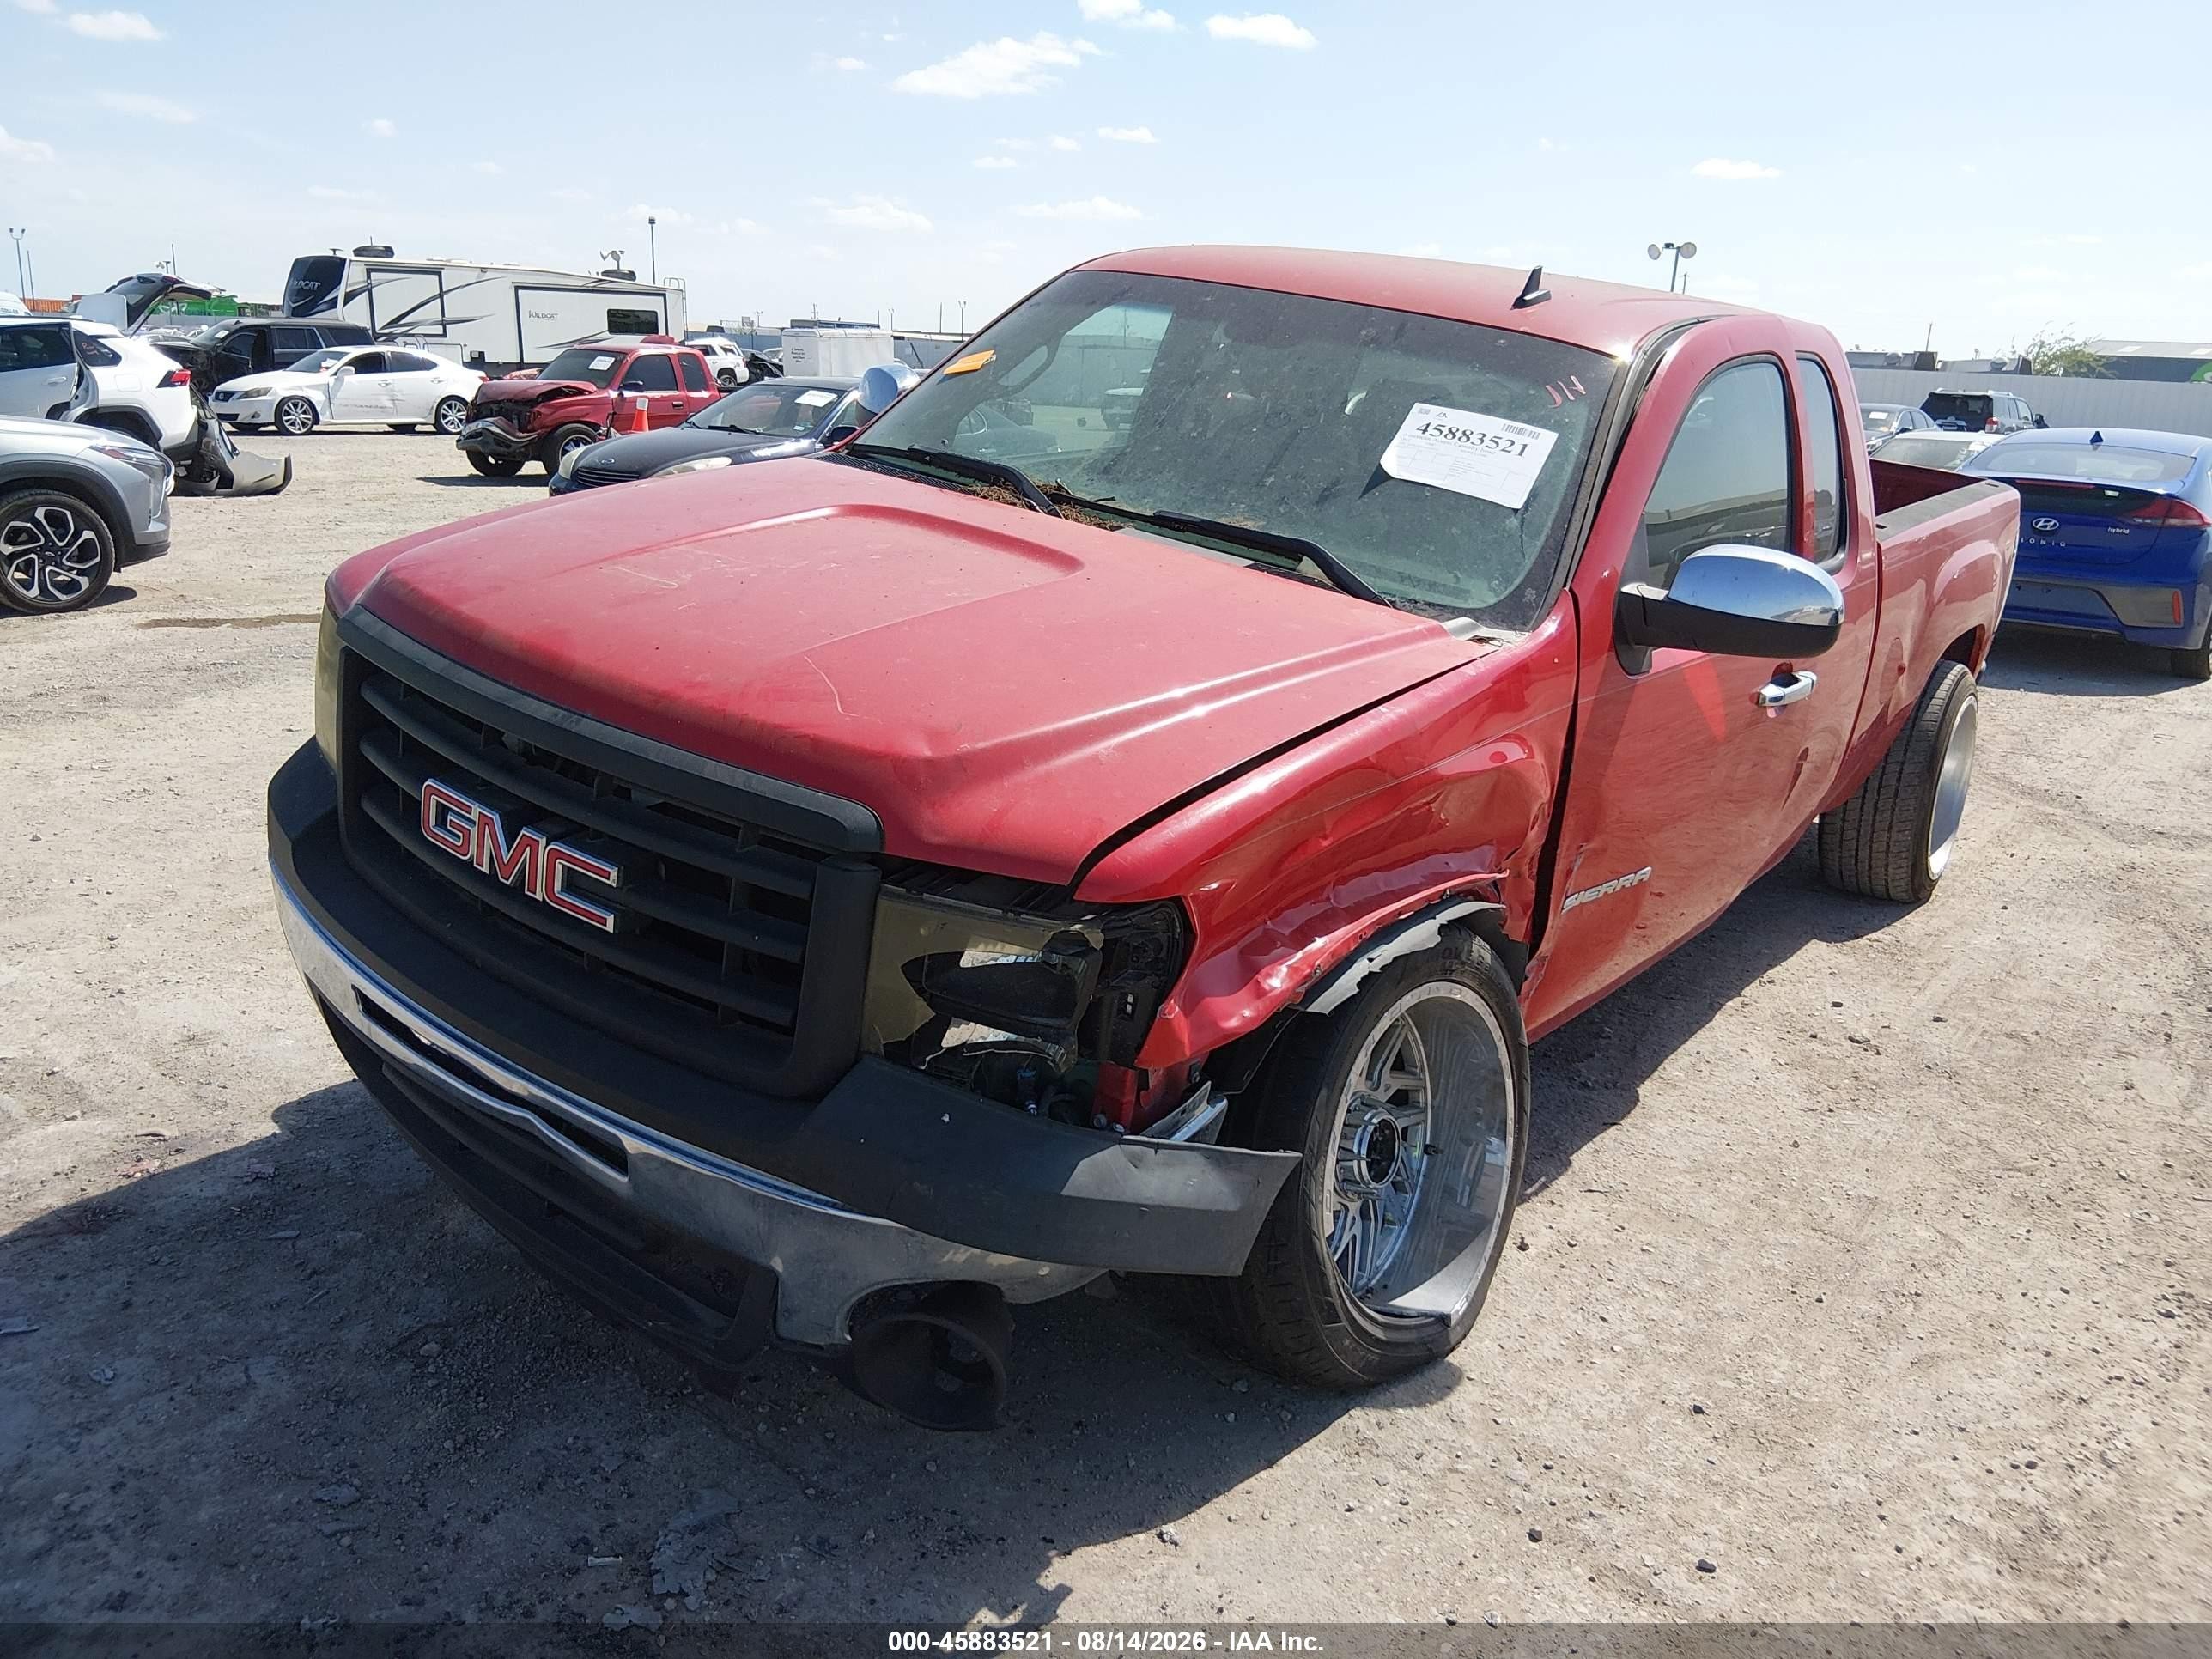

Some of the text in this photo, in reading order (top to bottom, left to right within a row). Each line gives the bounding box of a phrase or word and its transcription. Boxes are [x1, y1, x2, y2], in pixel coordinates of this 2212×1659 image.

[1416, 421, 1531, 458] 45883521
[421, 778, 618, 934] GMC
[1561, 866, 1652, 915] SIERRA
